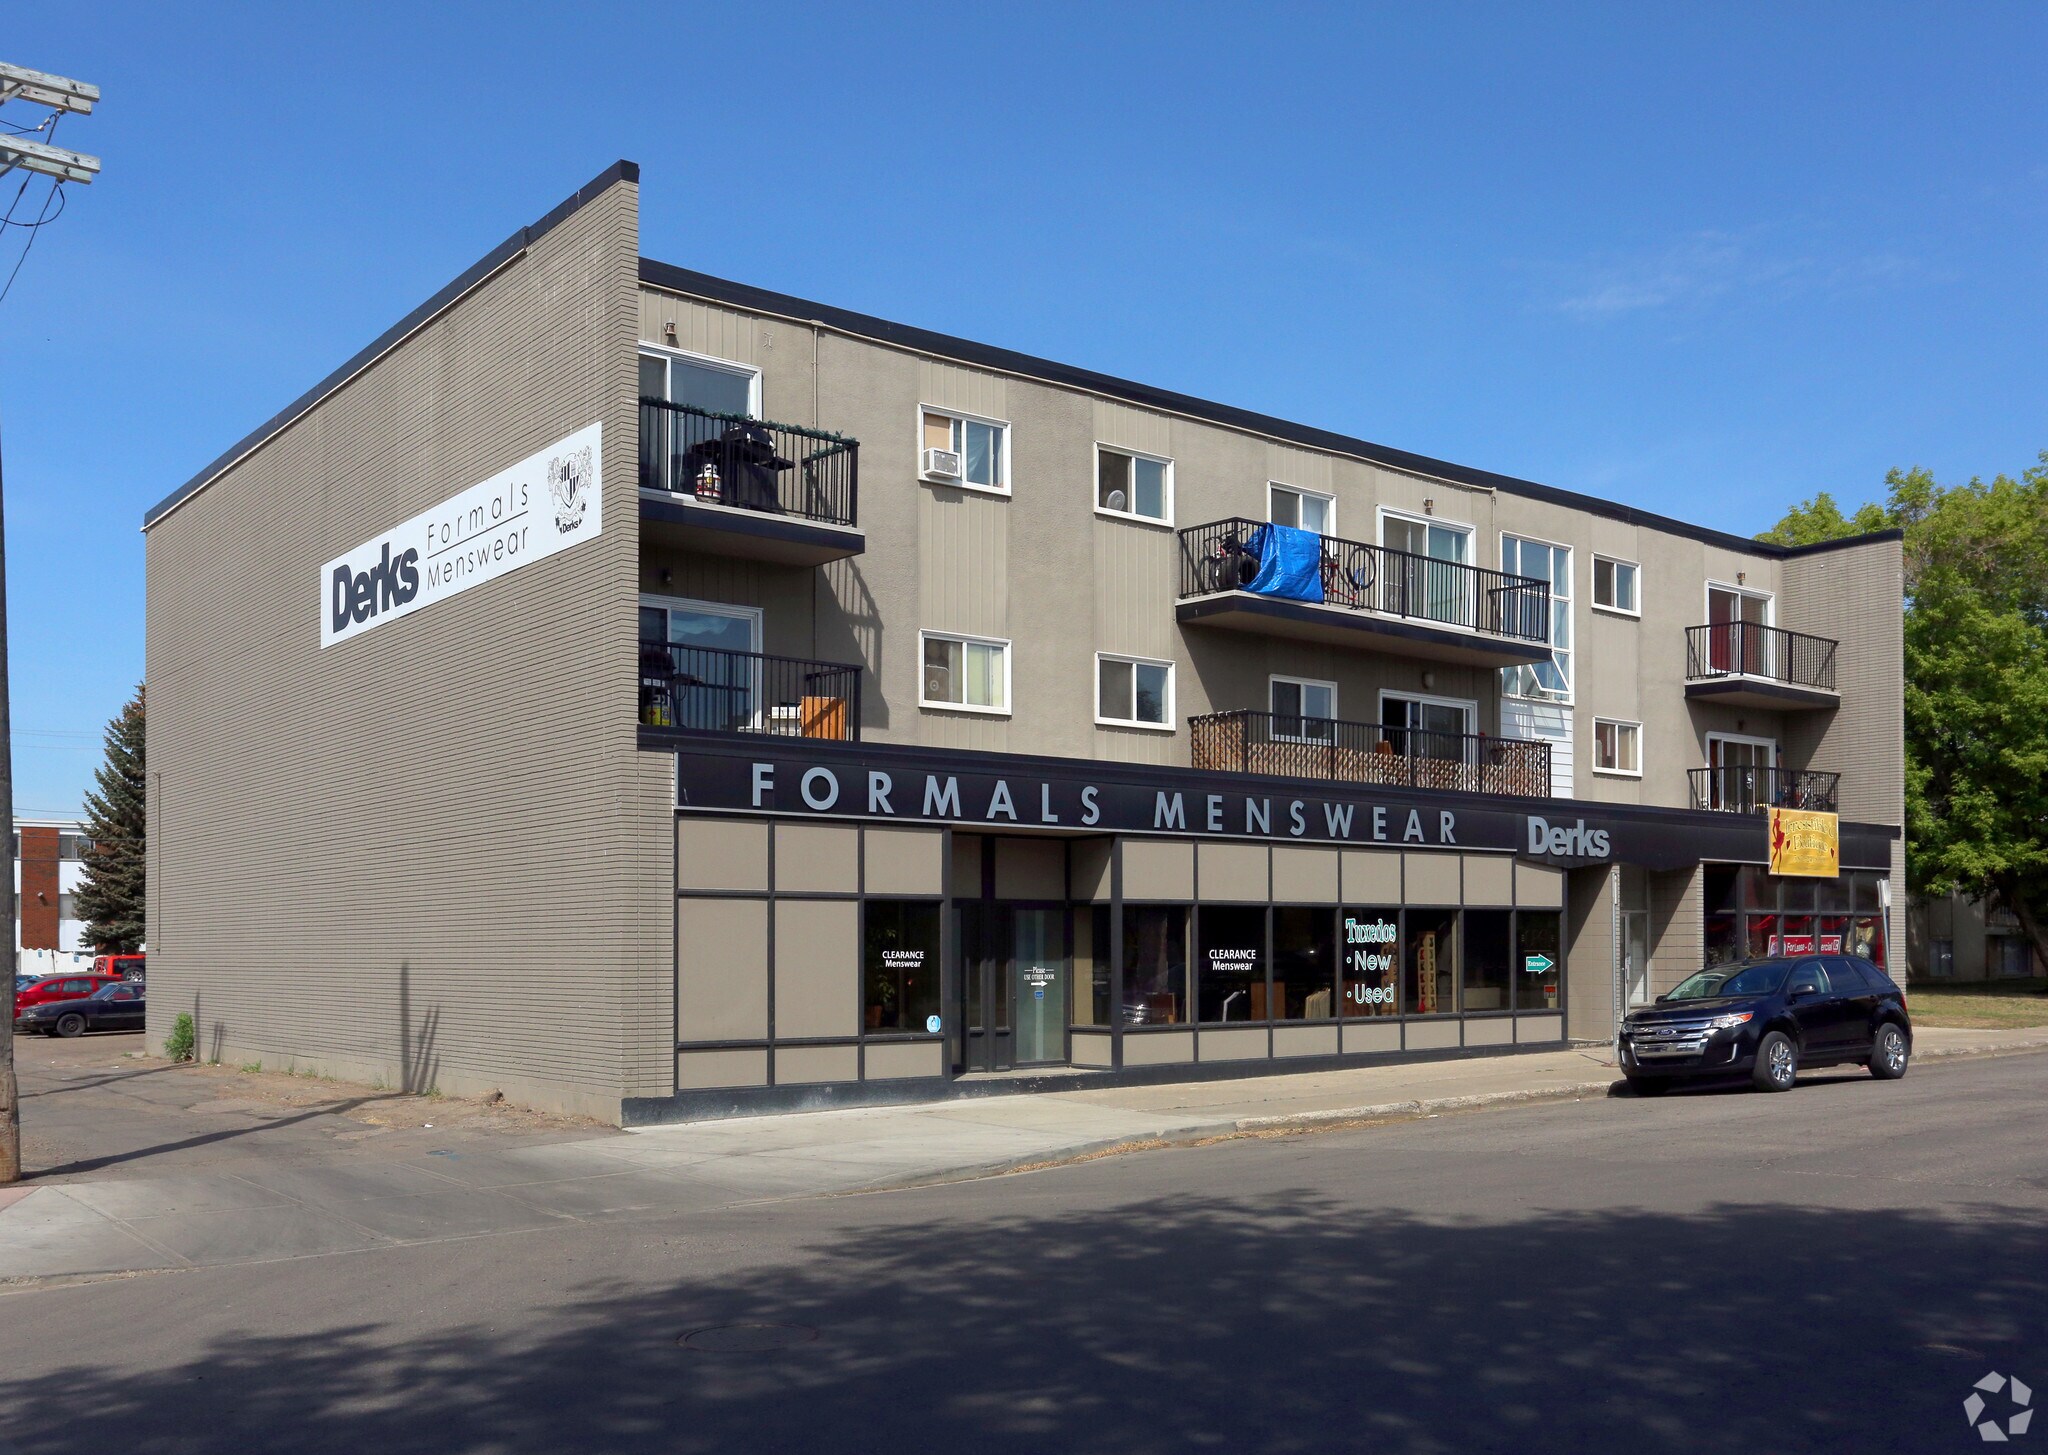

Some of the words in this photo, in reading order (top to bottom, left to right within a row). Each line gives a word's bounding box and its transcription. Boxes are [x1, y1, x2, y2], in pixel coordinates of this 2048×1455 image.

[427, 482, 529, 551] Formals
[562, 520, 579, 534] Derks
[427, 525, 529, 591] Menswear
[332, 541, 419, 634] Derks
[751, 762, 1101, 826] FORMALS
[1153, 791, 1457, 844] MENSWEAR
[1526, 815, 1611, 858] Derks
[1345, 917, 1397, 943] Tuxedos
[881, 950, 925, 959] CLEARANCE
[885, 959, 922, 968] Menswear
[1209, 949, 1256, 960] CLEARANCE
[1354, 950, 1392, 971] New
[1212, 960, 1253, 971] Menswear
[1354, 983, 1395, 1004] Used
